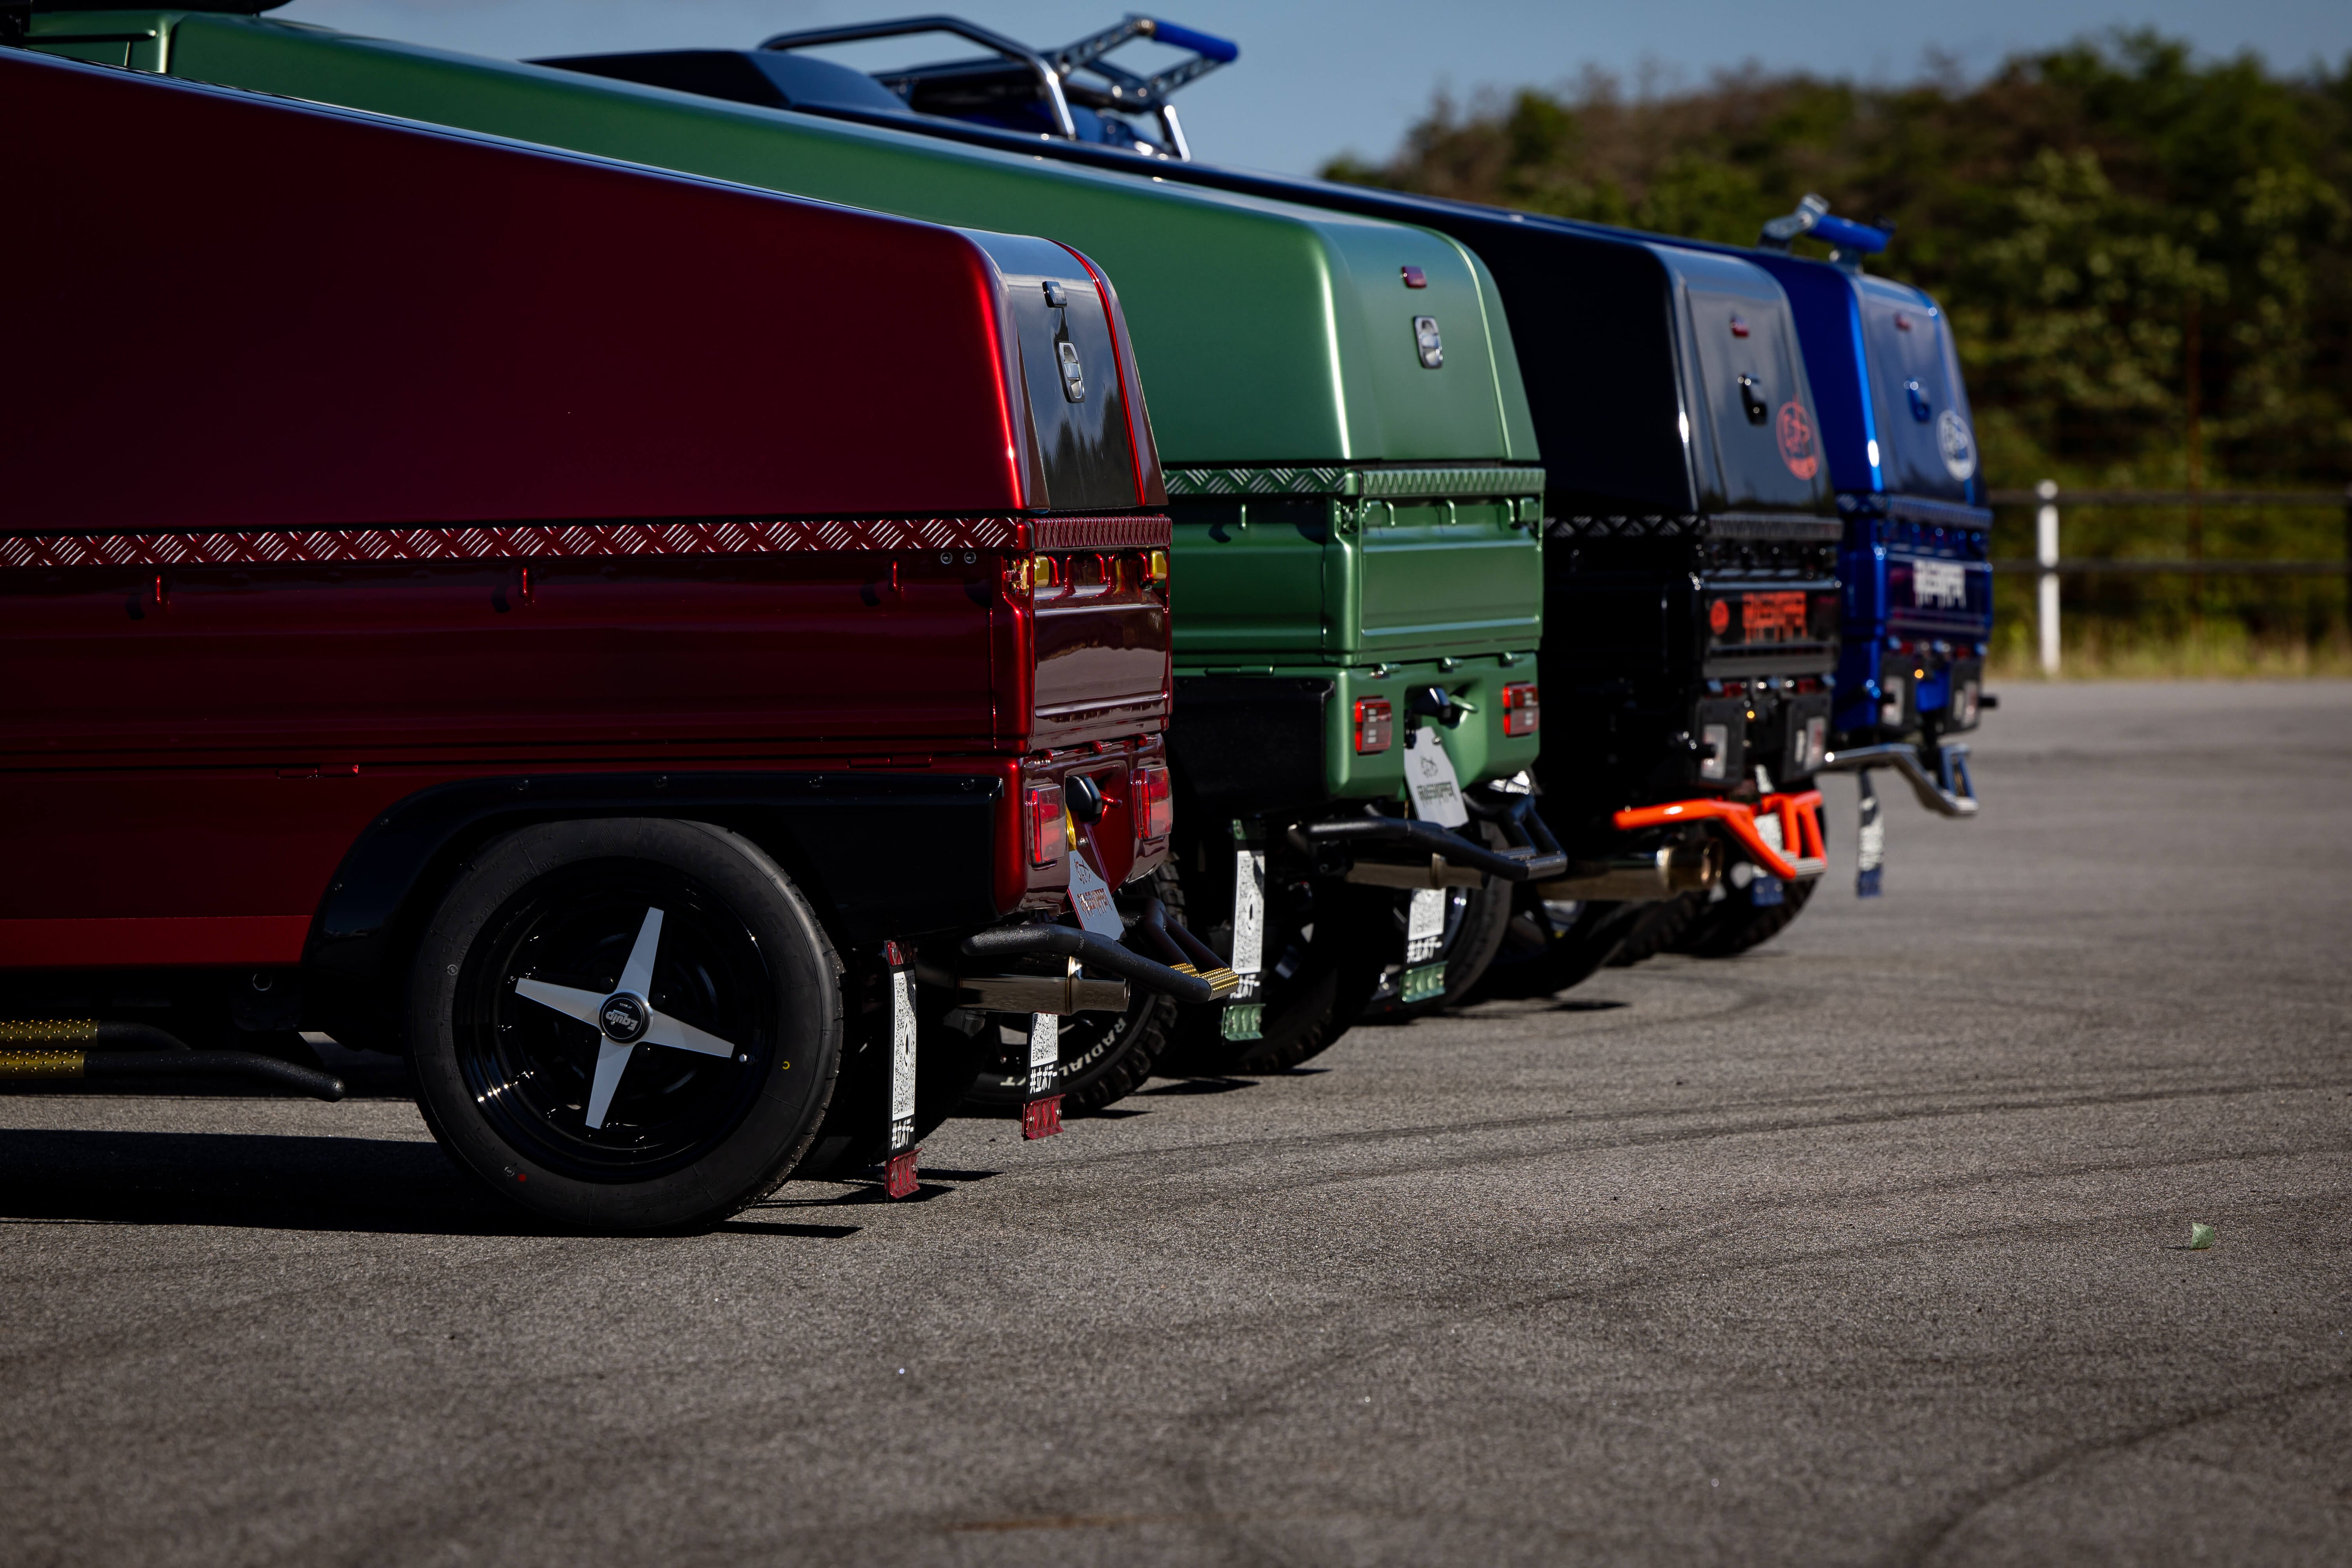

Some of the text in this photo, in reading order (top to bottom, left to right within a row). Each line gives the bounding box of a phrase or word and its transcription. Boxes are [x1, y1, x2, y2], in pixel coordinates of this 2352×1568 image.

[606, 1009, 638, 1031] Equip
[1059, 1017, 1127, 1077] RADIAL
[1030, 1063, 1057, 1094] 共立ボデー
[892, 1118, 914, 1150] 共立ボデー
